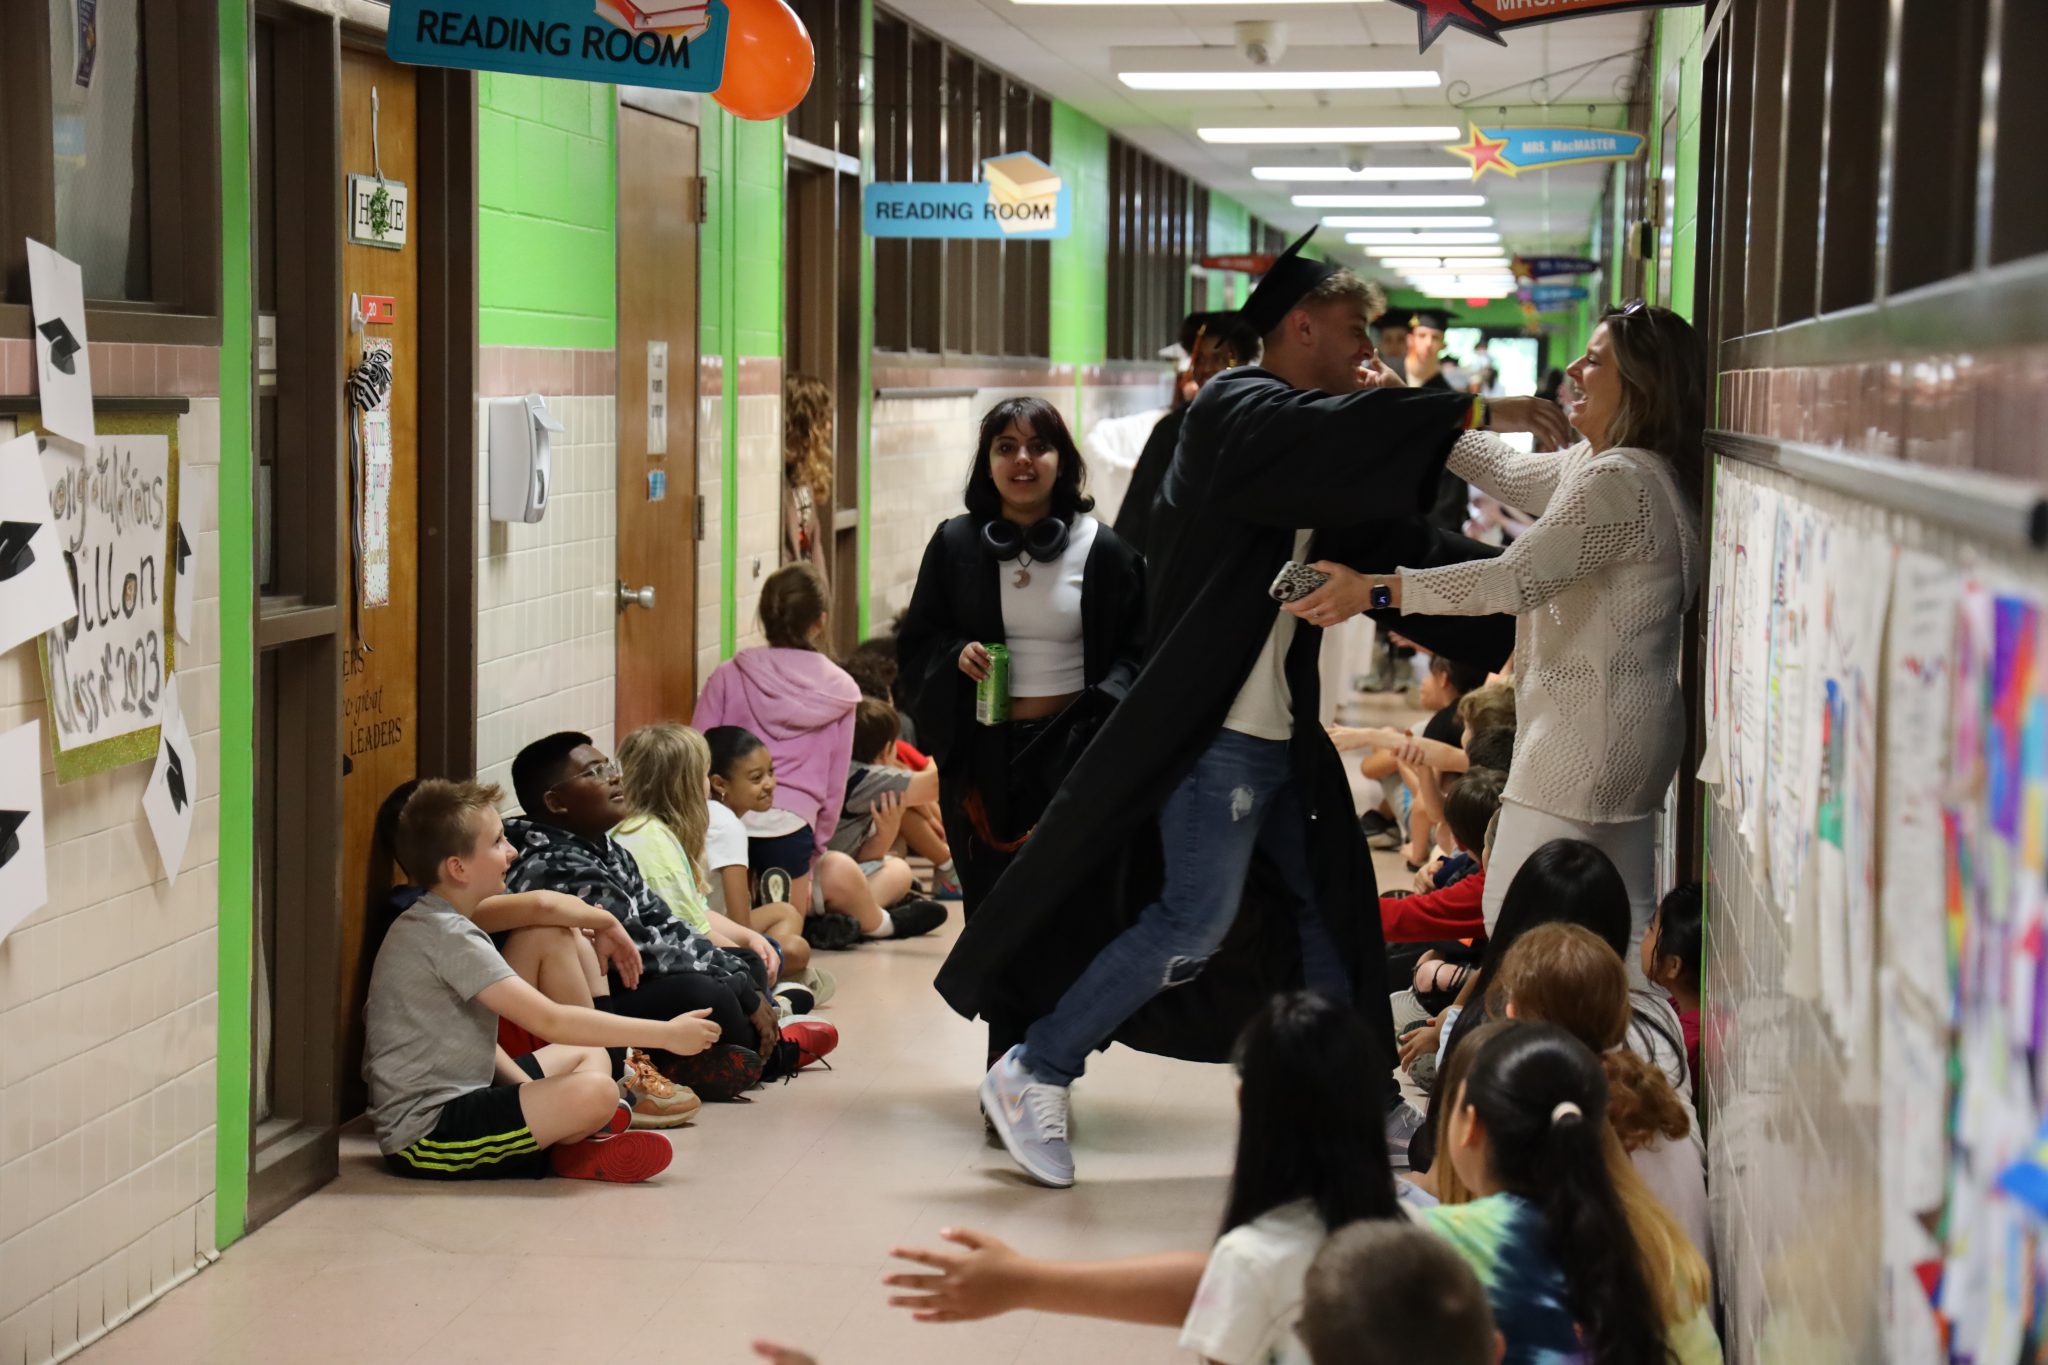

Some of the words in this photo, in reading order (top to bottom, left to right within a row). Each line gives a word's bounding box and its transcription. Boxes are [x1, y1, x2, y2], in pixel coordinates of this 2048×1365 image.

[416, 9, 571, 56] READING
[582, 25, 691, 69] ROOM
[359, 193, 404, 231] HME
[876, 202, 973, 220] READING
[984, 202, 1050, 220] ROOM
[368, 302, 377, 316] 20
[46, 441, 164, 554] ongratulations
[343, 647, 365, 677] ERS
[50, 630, 99, 734] Class
[100, 642, 116, 718] of
[116, 630, 160, 718] 2023
[350, 717, 402, 756] LEADERS
